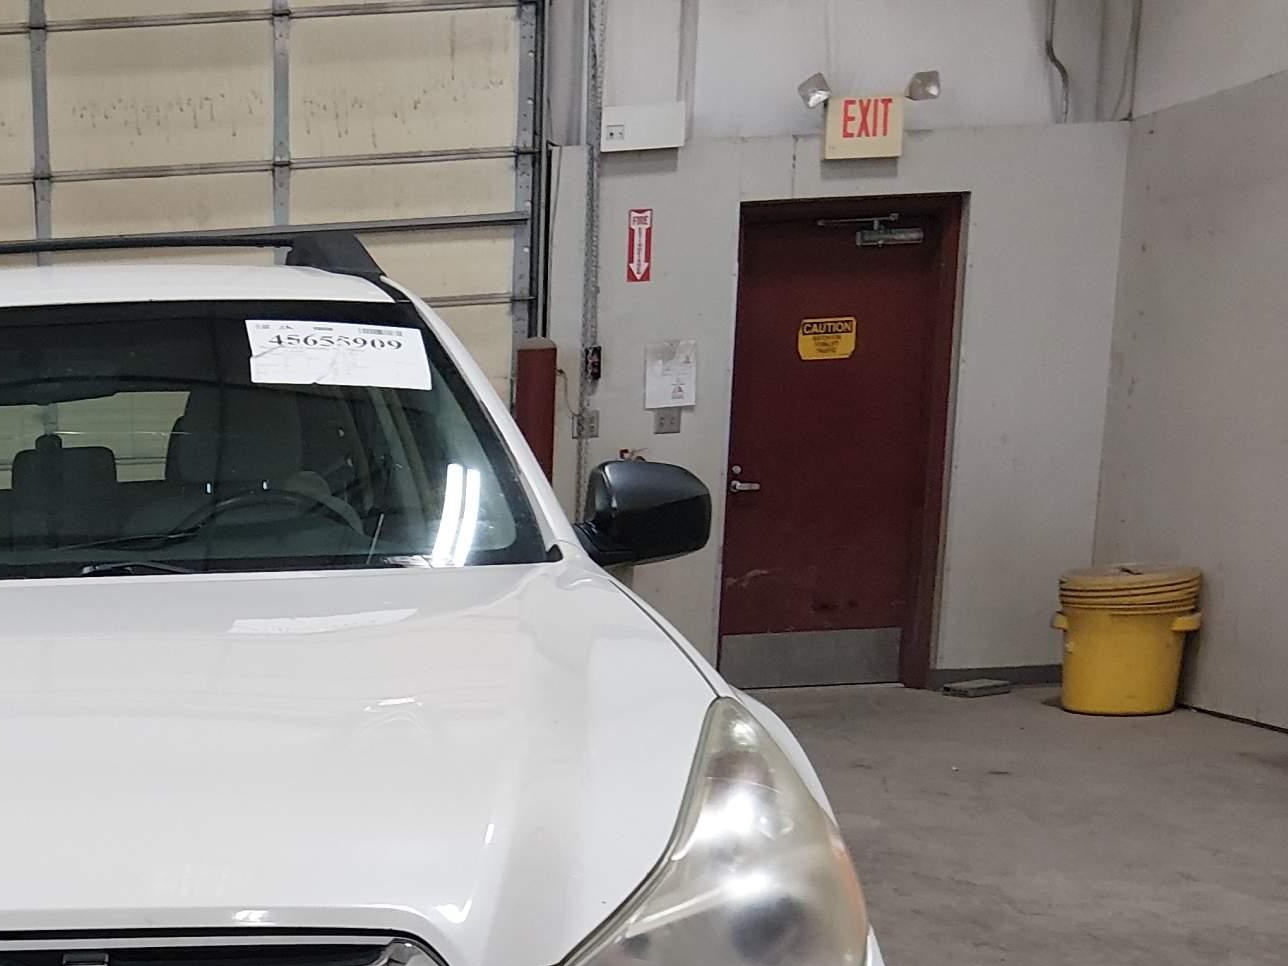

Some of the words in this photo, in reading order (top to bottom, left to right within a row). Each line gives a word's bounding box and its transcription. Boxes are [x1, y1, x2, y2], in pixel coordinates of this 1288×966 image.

[842, 98, 893, 138] EXIT
[803, 321, 852, 334] CAUTION
[268, 333, 403, 351] 45655909
